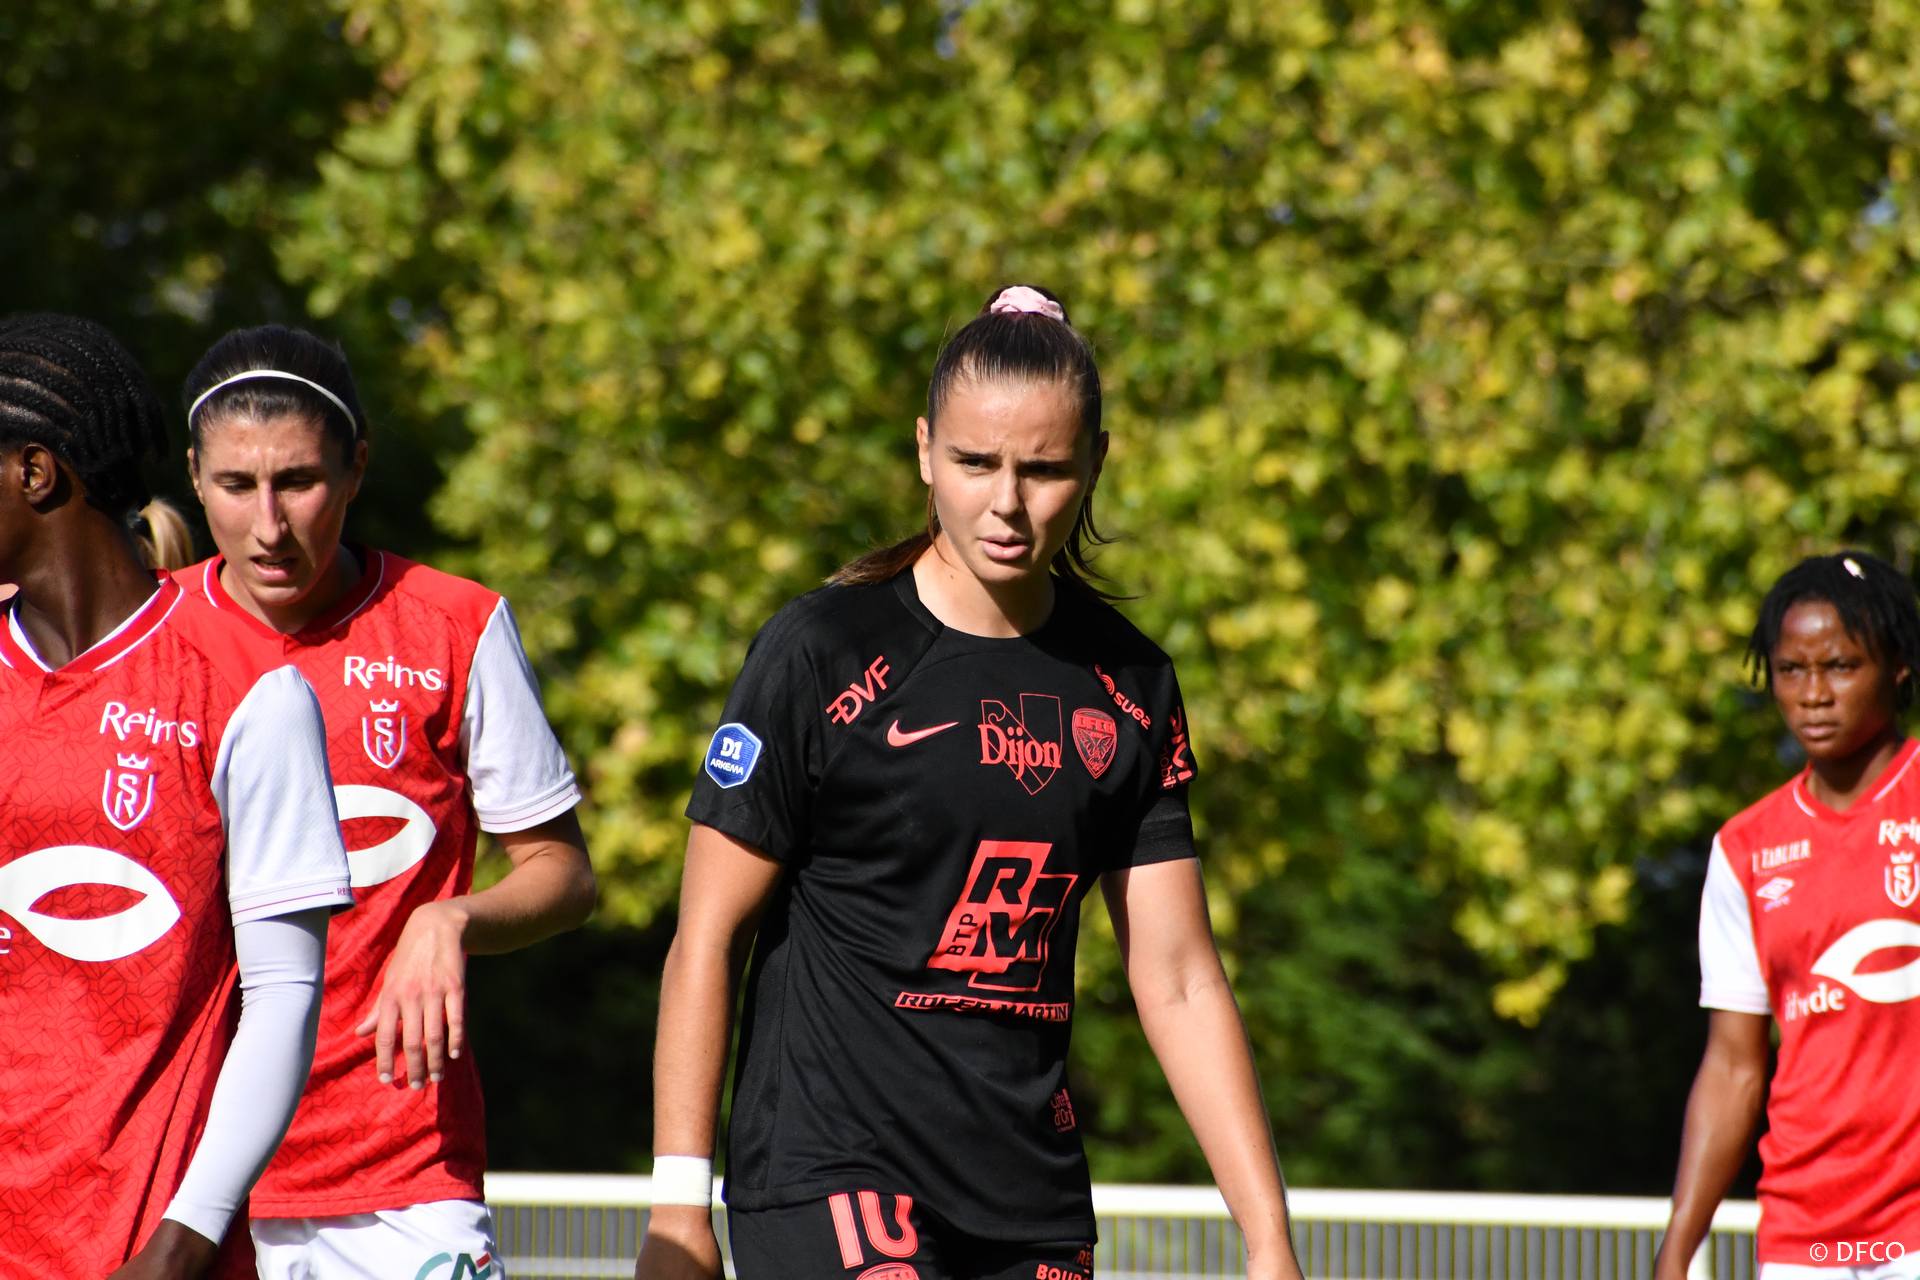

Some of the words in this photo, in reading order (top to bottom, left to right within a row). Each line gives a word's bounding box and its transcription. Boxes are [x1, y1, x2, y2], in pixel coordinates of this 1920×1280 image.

[825, 655, 891, 726] DVF
[1113, 691, 1152, 731] suez
[99, 701, 199, 748] Reims
[709, 757, 745, 776] ARKEMA
[719, 736, 743, 761] D1
[977, 723, 1062, 781] Dijon
[945, 912, 979, 956] BTP
[827, 1190, 919, 1270] 10
